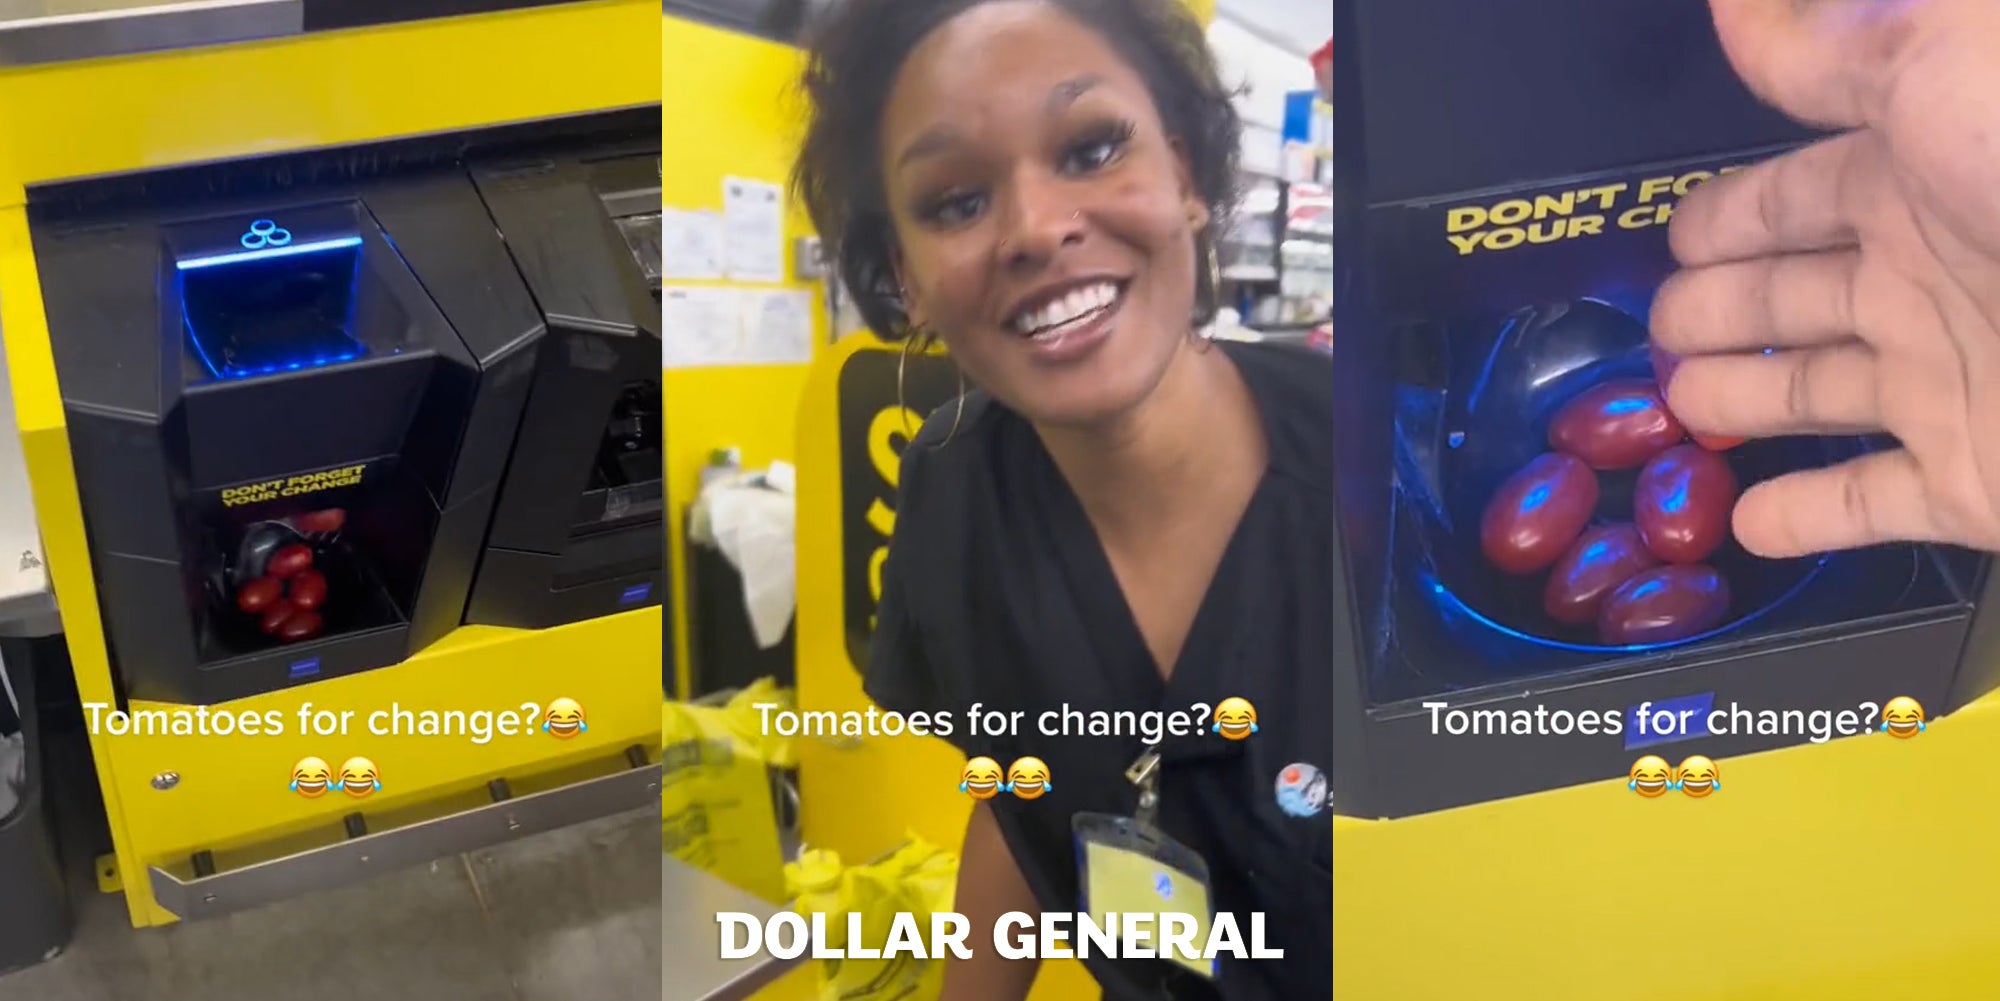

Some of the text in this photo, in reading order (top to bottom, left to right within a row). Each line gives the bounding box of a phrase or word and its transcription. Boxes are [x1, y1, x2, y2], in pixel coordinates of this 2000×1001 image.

[1447, 183, 1628, 233] DON'T
[1446, 214, 1605, 256] YOUR
[221, 464, 367, 499] DON'T FORGET
[222, 475, 362, 508] YOUR CHANGE
